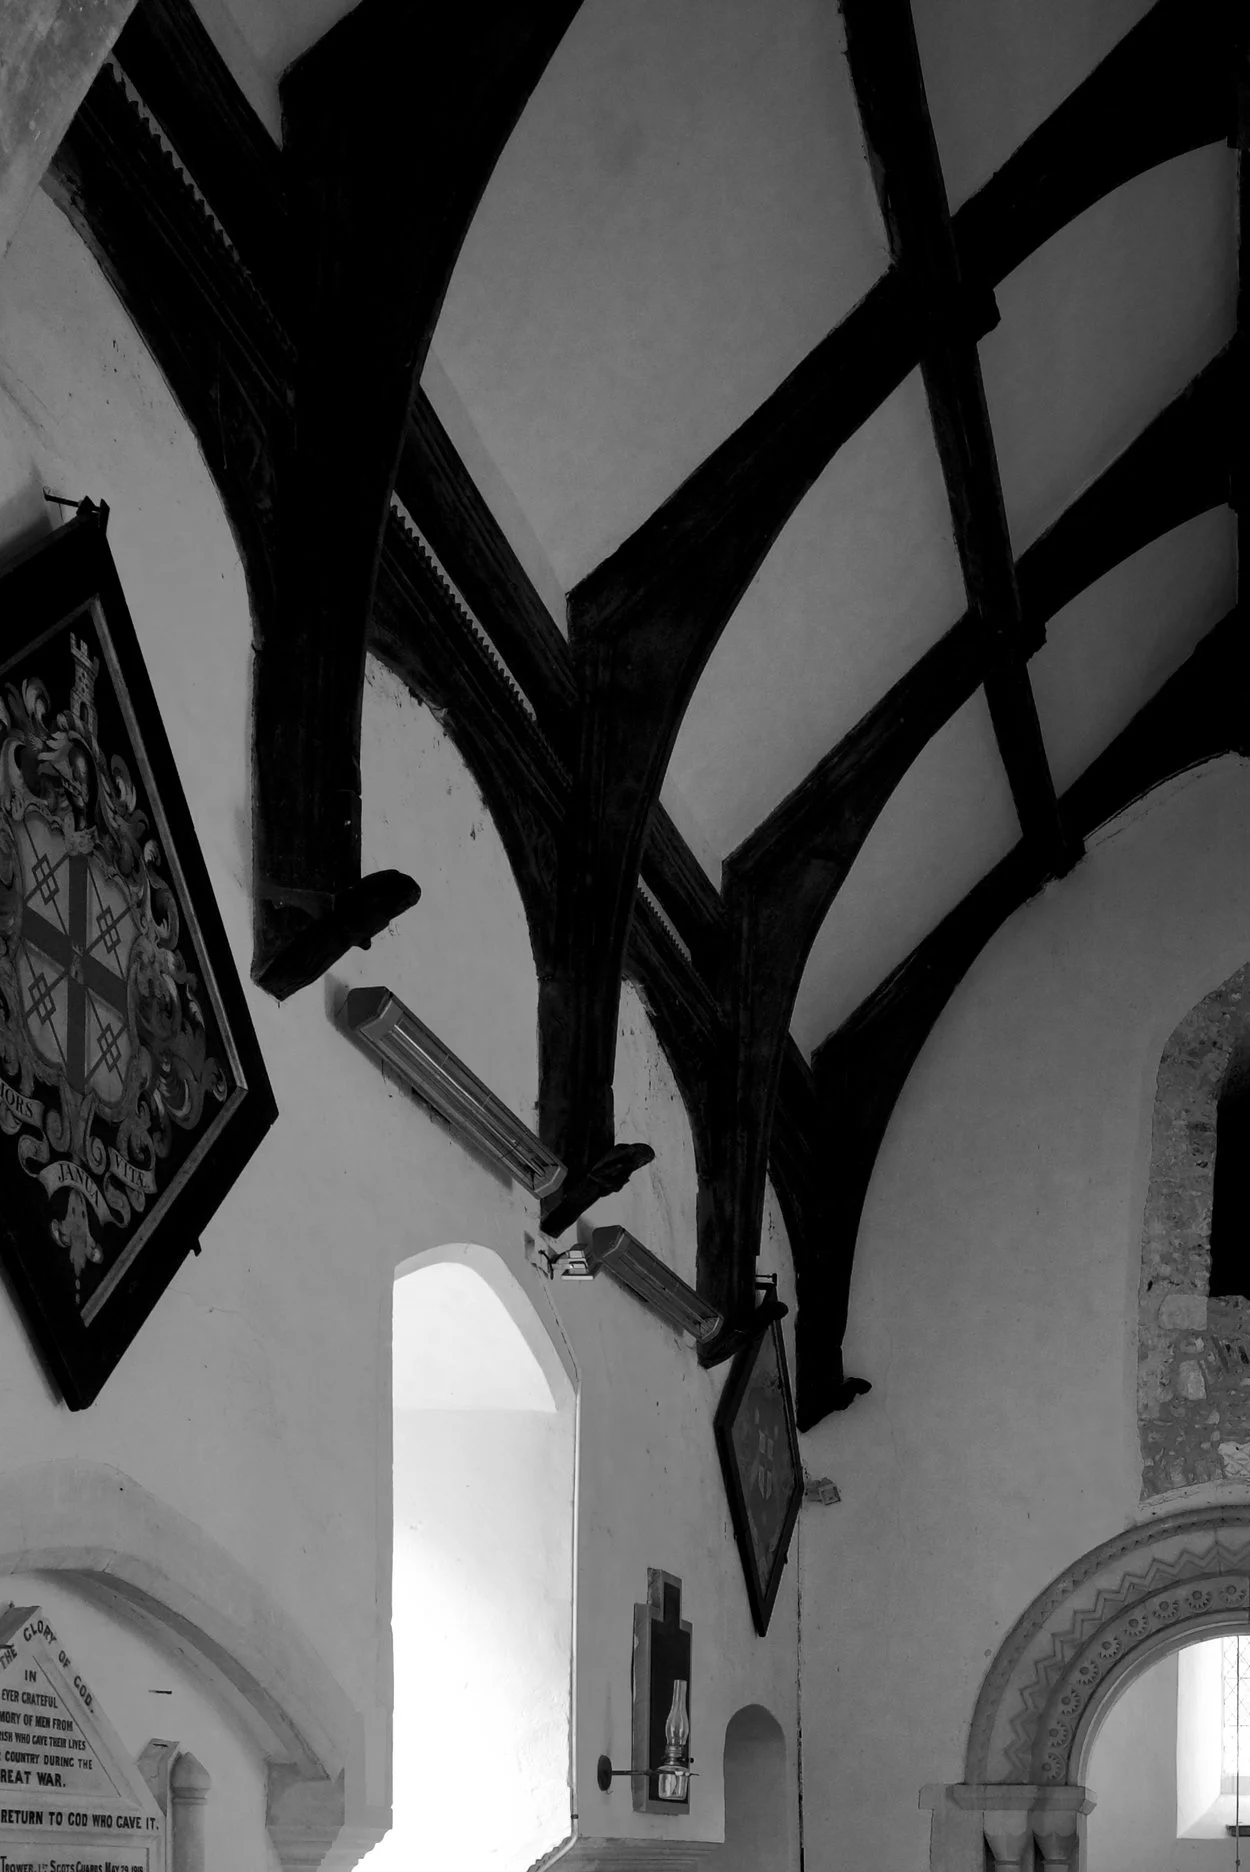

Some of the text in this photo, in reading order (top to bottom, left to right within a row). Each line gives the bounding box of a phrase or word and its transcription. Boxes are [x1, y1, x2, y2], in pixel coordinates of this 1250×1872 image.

[58, 1163, 99, 1208] JANUA
[0, 1620, 95, 1714] THE GLORY OF GOD.
[24, 1669, 37, 1683] IN
[1, 1688, 58, 1709] EVER GRATEFUL
[23, 1714, 33, 1726] OF
[35, 1715, 51, 1729] MEN
[52, 1718, 74, 1732] FROM
[15, 1732, 30, 1744] WHO
[32, 1734, 48, 1746] GAVE
[49, 1736, 67, 1748] THEIR
[68, 1738, 86, 1751] LIVES
[5, 1750, 93, 1770] COUNTRY DURING THE
[36, 1771, 66, 1788] WAR.
[1, 1809, 159, 1830] RETURN TO GOD WHO GAVE IT.
